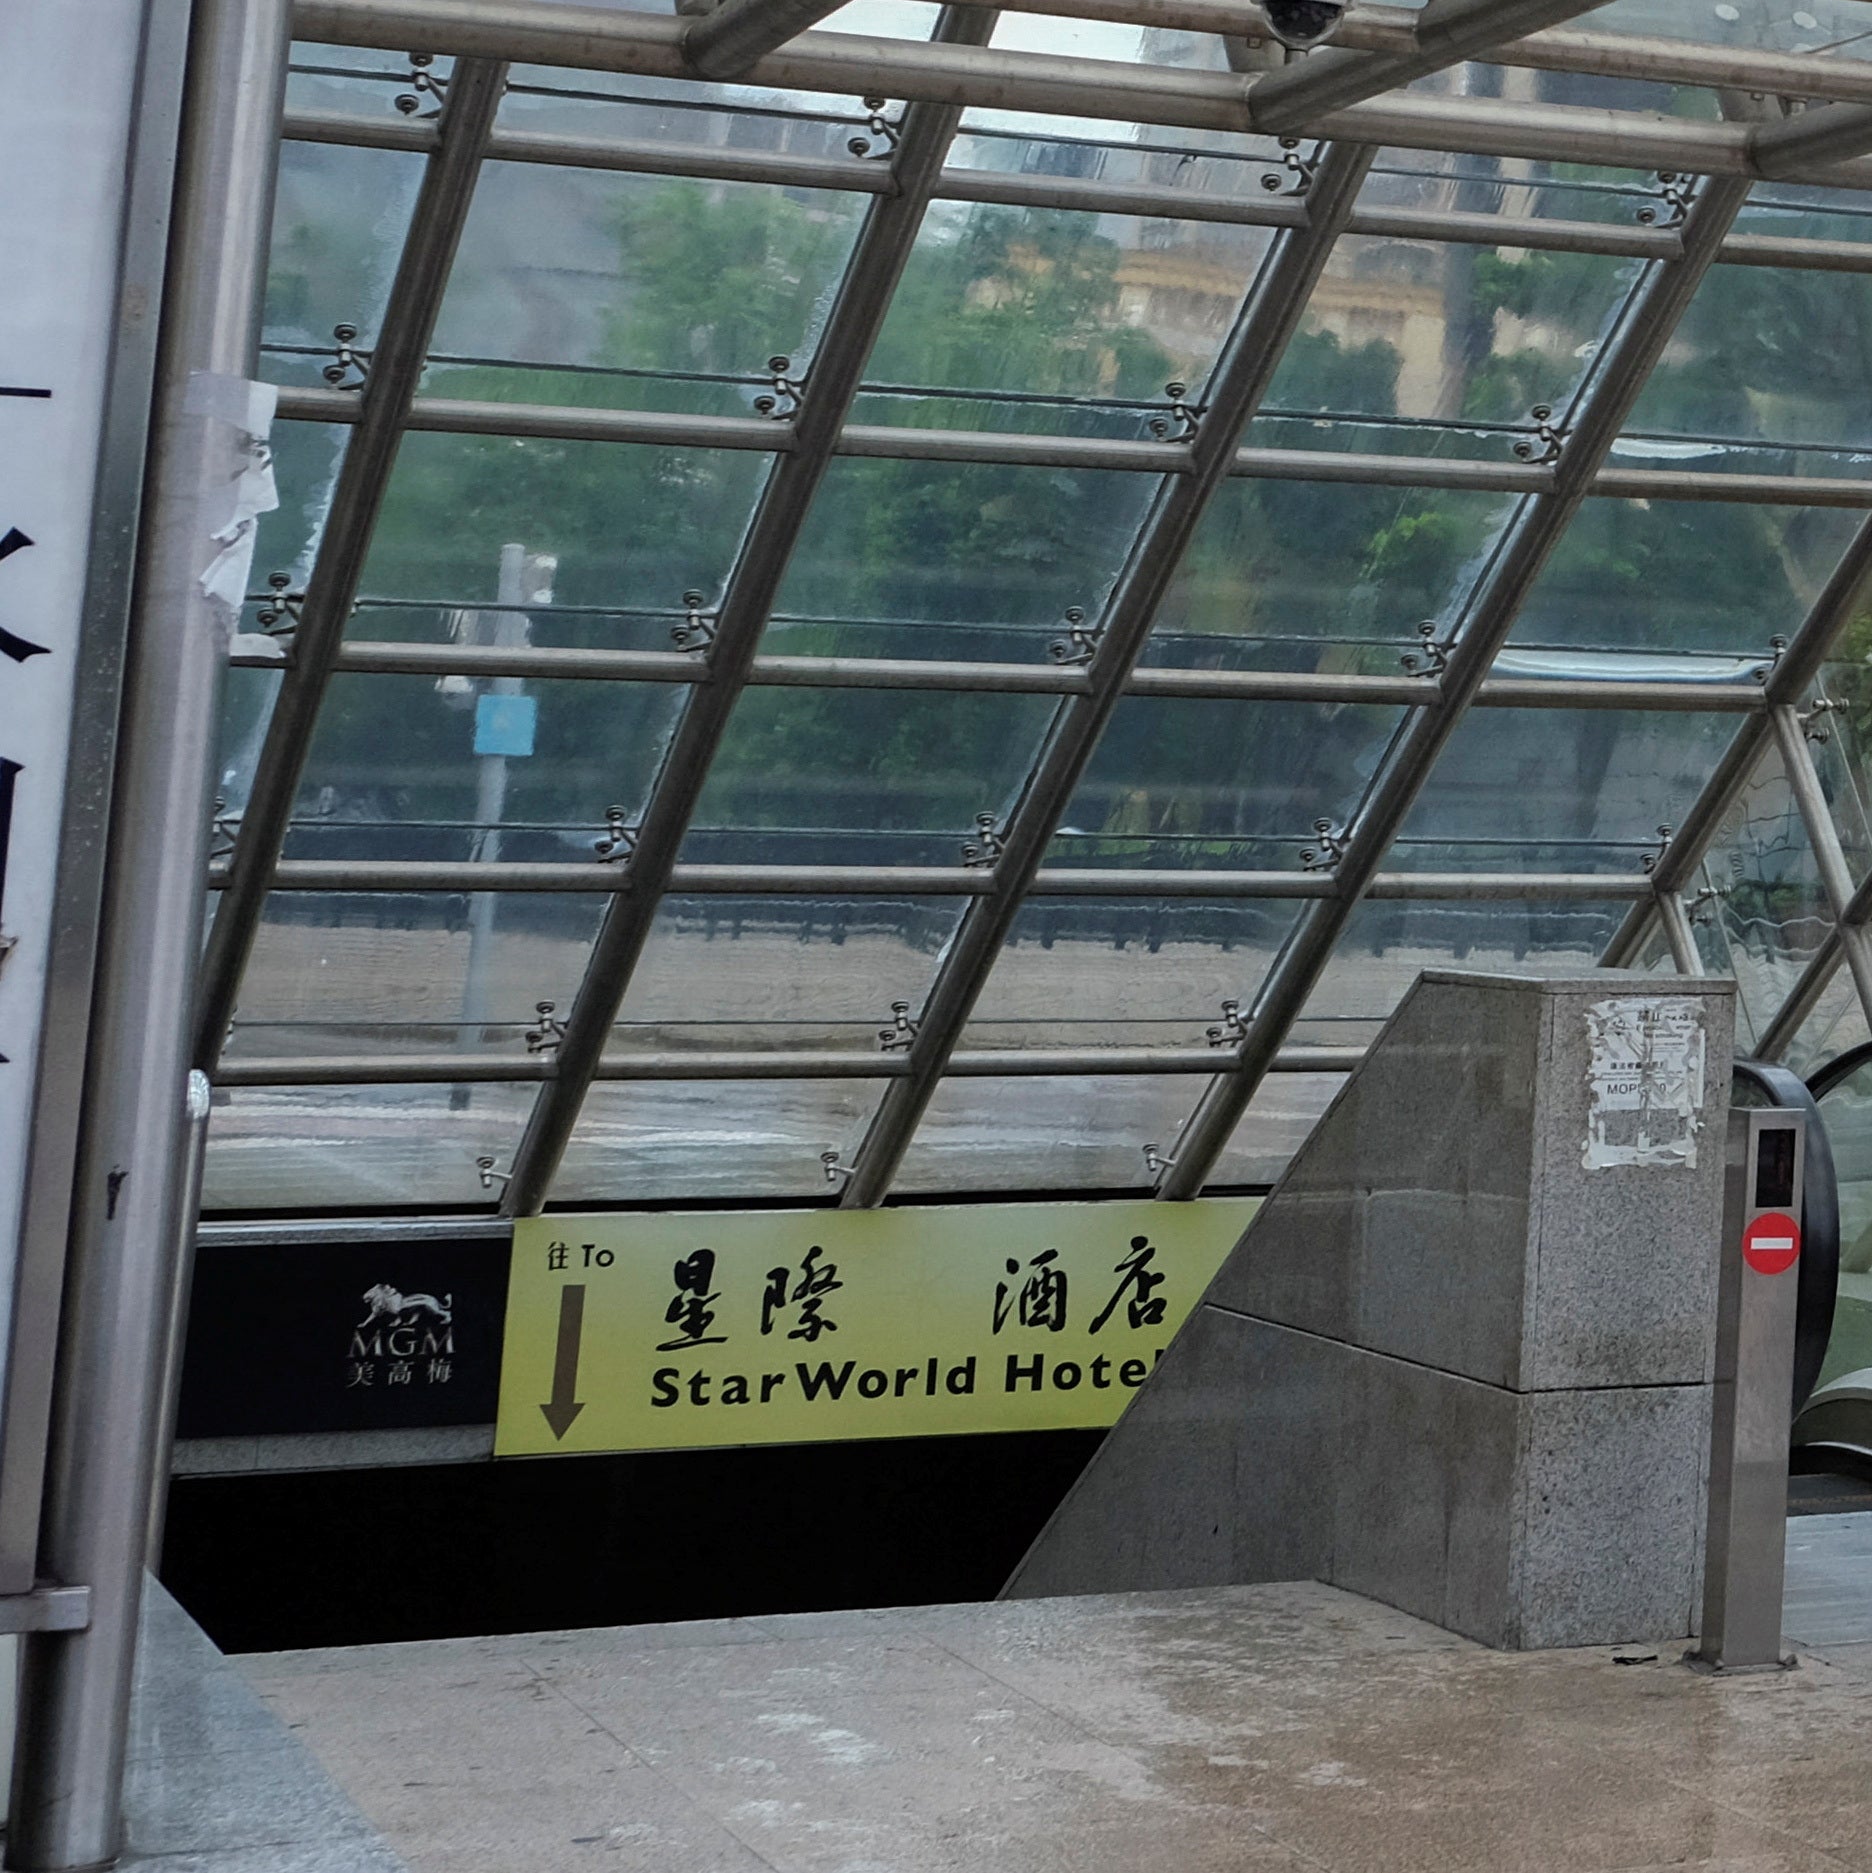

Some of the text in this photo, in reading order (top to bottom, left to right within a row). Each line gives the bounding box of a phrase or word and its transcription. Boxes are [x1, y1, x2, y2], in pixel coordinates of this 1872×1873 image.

[547, 1241, 615, 1271] 往 To
[345, 1328, 456, 1358] MGM
[345, 1358, 453, 1389] 美高梅
